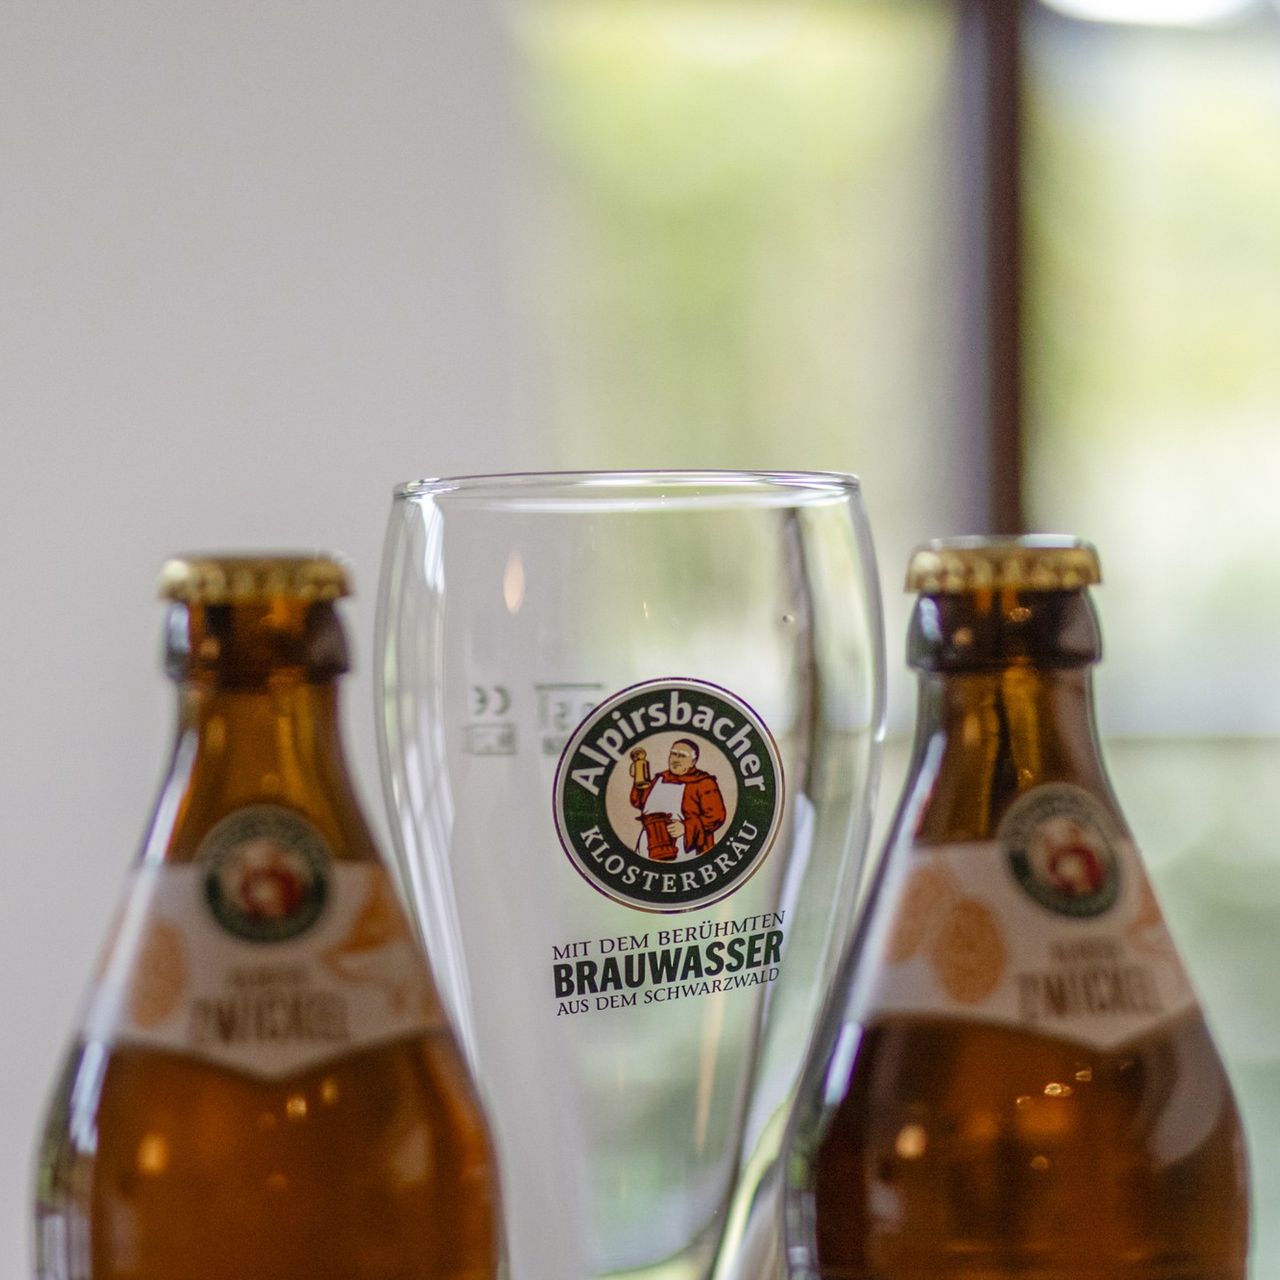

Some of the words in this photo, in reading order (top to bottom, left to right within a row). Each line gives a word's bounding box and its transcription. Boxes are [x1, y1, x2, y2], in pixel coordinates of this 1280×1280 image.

[571, 691, 765, 796] Alpirsbacher
[580, 820, 759, 893] KLOSTERBRÄU
[552, 941, 591, 960] MIT
[600, 934, 649, 954] DEM
[658, 910, 786, 946] BERÜHMTEN
[553, 930, 784, 999] BRAUWASSER
[557, 1000, 590, 1017] AUS
[596, 992, 637, 1012] DEM
[644, 967, 780, 1005] SCHWARZWALD
